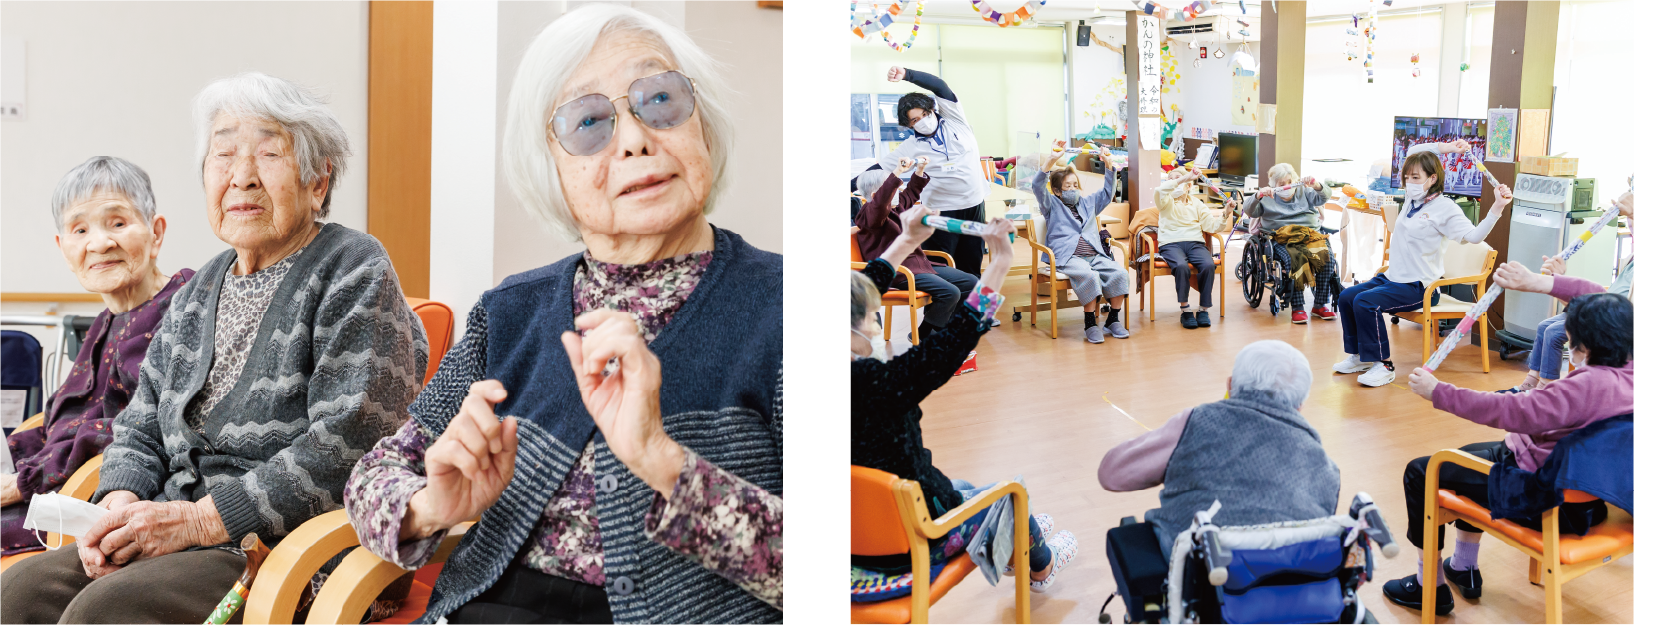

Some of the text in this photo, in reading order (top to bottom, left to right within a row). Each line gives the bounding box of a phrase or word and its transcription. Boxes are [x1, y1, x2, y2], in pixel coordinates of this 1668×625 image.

[1142, 17, 1157, 76] かんの神社
